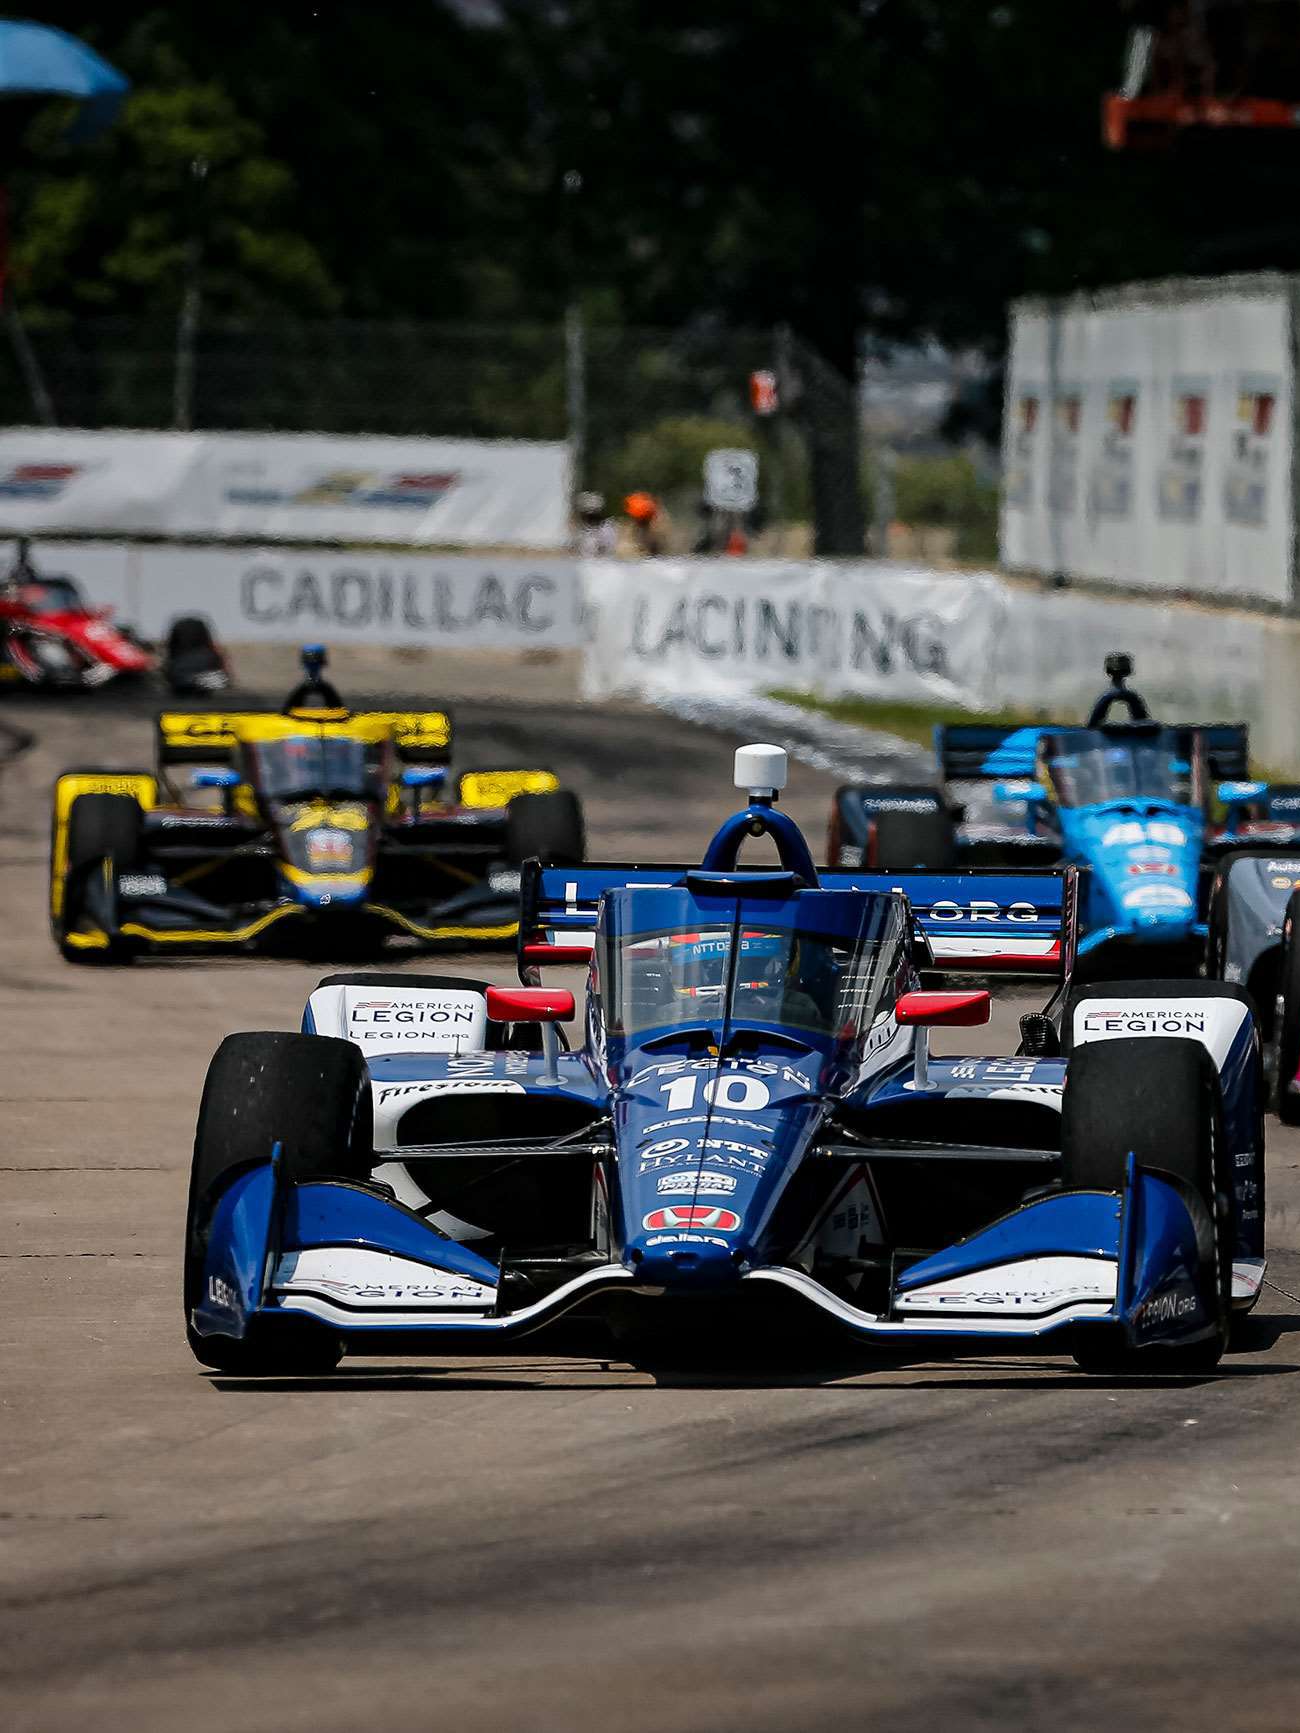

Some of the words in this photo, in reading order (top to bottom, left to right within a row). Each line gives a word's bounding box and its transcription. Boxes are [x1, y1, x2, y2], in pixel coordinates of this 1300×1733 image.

[241, 566, 556, 632] CADILLAC
[692, 943, 715, 955] NTT
[390, 1002, 474, 1010] AMERICAN
[351, 1010, 474, 1023] LEGION
[1121, 1011, 1203, 1019] AMERICAN
[1084, 1020, 1205, 1032] LEGION
[378, 1081, 515, 1106] Firestone
[659, 1074, 771, 1112] 10
[696, 1138, 769, 1160] NTT
[639, 1154, 766, 1172] HYLANT
[646, 1233, 730, 1249] dallara
[355, 1290, 483, 1298] GION
